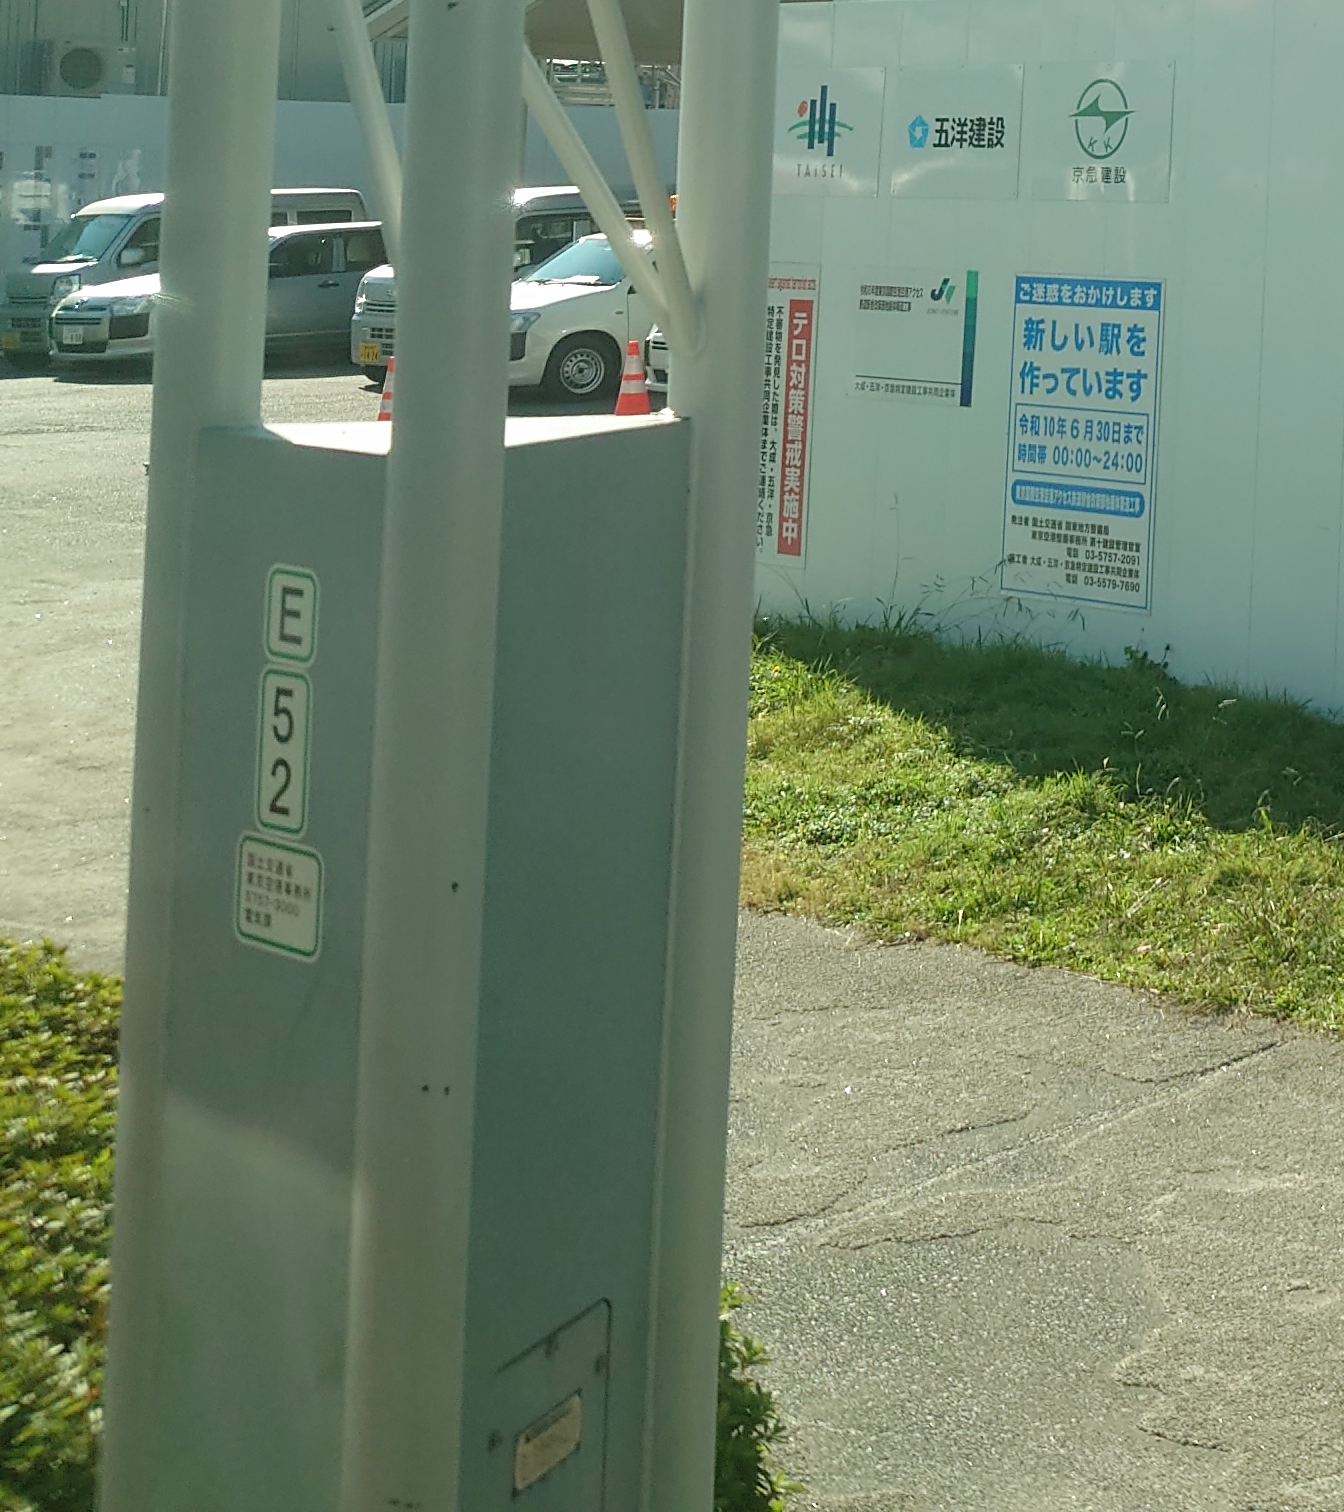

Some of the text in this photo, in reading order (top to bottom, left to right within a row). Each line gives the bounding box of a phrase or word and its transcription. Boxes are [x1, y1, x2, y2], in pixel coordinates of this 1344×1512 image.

[932, 116, 1006, 149] 五洋建設
[1072, 165, 1127, 185] 京急建設
[1019, 282, 1158, 306] ご迷惑をおかけします
[1023, 317, 1146, 356] 新しい駅を
[1019, 360, 1148, 402] 作っています
[782, 311, 808, 546] テロ対策警戒実施中
[1017, 443, 1047, 464] 時間帯
[1084, 549, 1140, 566] 03-5757-2091
[278, 584, 304, 645] E
